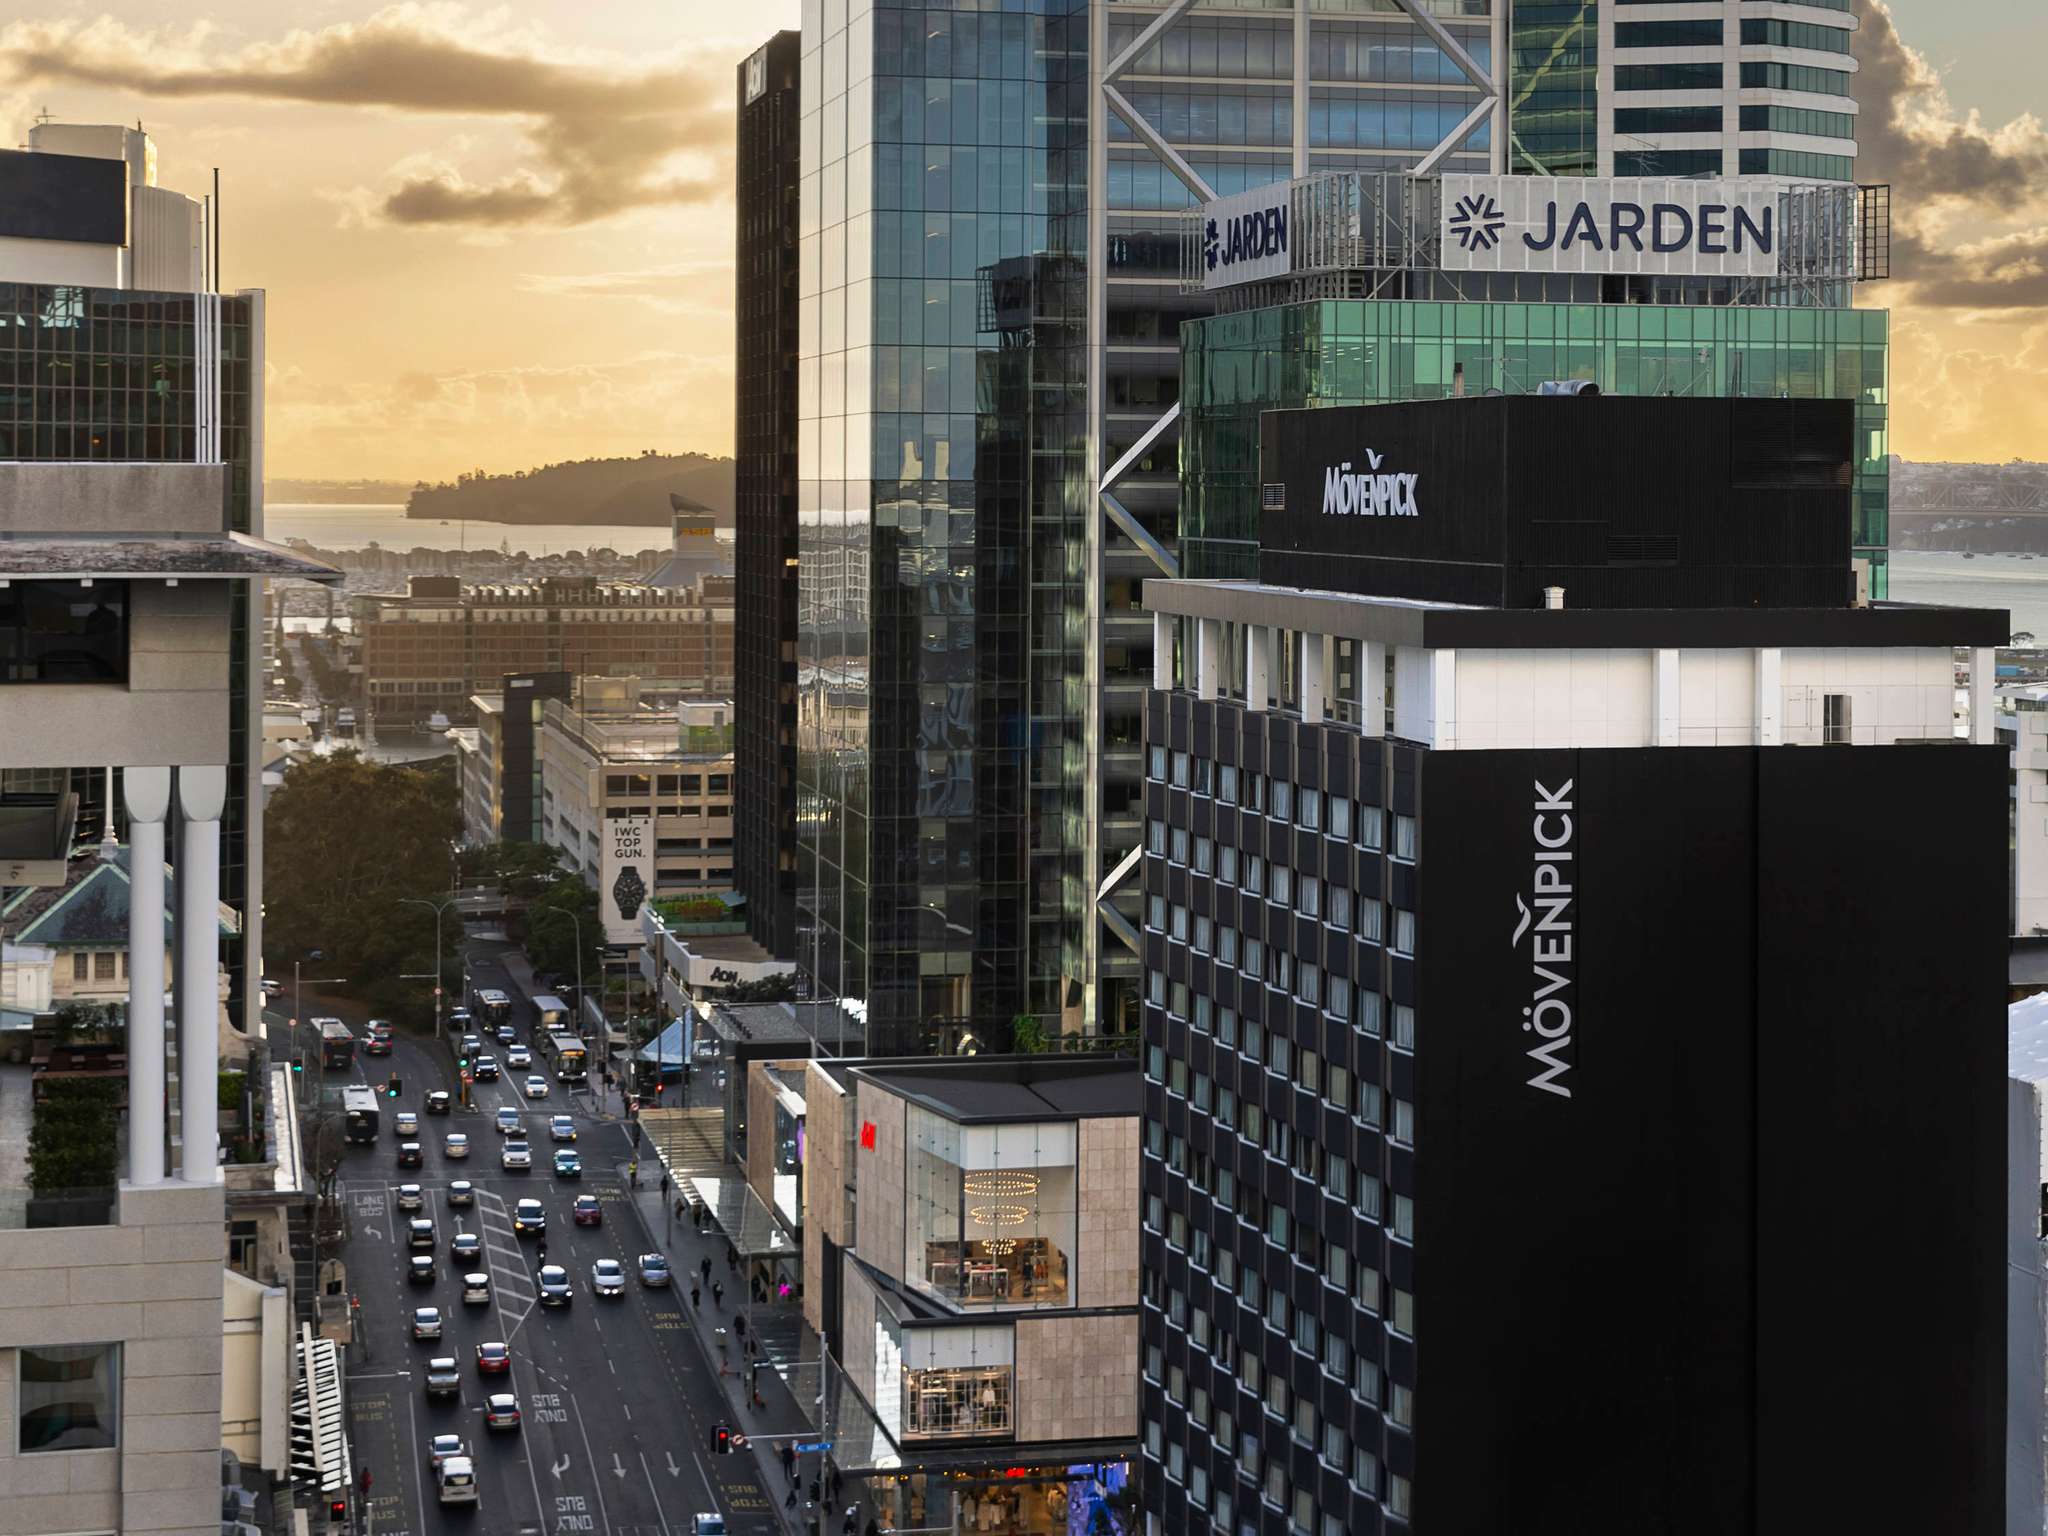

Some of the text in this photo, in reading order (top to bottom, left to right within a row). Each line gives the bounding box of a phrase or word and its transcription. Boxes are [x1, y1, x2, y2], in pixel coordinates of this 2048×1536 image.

[1221, 204, 1287, 265] JARDEN
[1522, 201, 1772, 254] JARDEN
[1322, 462, 1419, 517] MÖVENPICK
[615, 827, 641, 836] IWC
[615, 838, 641, 847] TOP
[614, 849, 646, 858] GUN.
[1523, 778, 1573, 1098] MÖVENPICK
[532, 1394, 561, 1407] BUS
[534, 1409, 568, 1423] ONLY
[556, 1496, 587, 1512] BUS
[556, 1515, 593, 1533] ONLY
